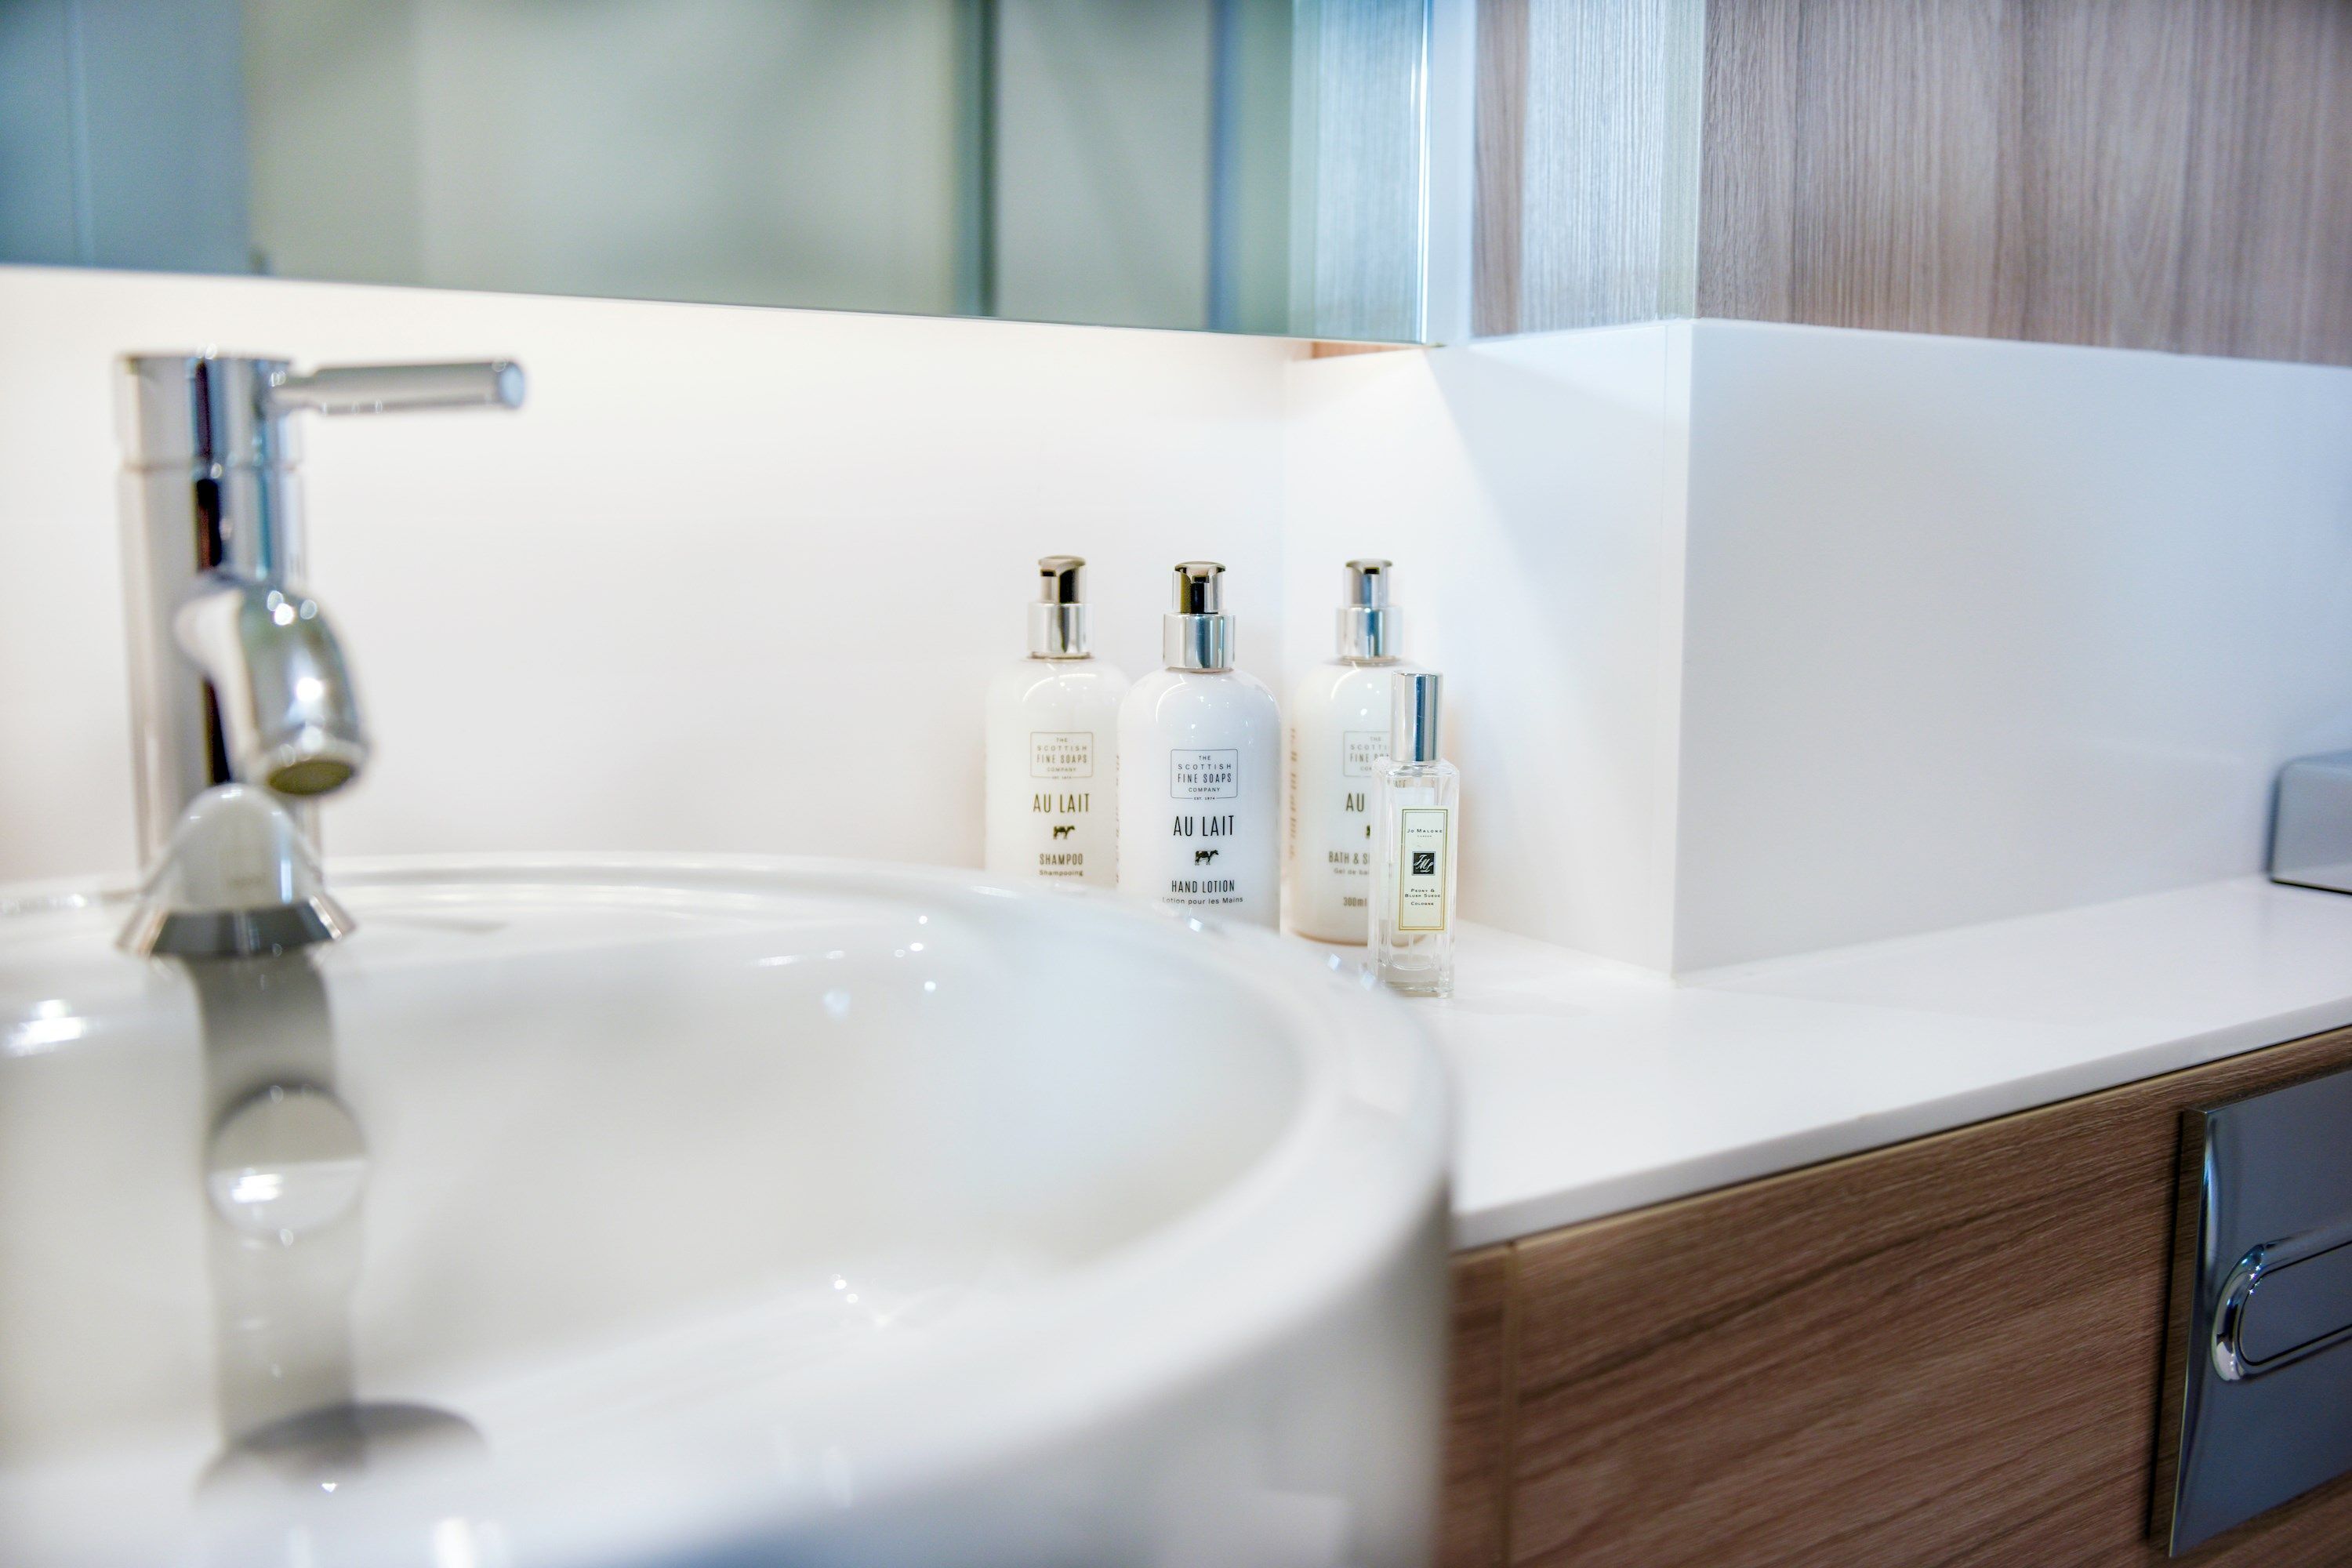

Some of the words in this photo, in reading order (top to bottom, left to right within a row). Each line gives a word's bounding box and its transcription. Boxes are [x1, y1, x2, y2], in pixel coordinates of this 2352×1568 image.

[1037, 754, 1055, 763] FINE
[1060, 754, 1087, 764] SOAPS
[1350, 753, 1369, 762] FINE
[1178, 773, 1198, 783] FINE
[1203, 773, 1231, 783] SOAPS
[1033, 793, 1051, 813] AU
[1060, 793, 1089, 813] LAIT
[1346, 793, 1365, 812] AU
[1173, 816, 1192, 836] AU
[1202, 815, 1234, 836] LAIT
[1040, 853, 1083, 865] SHAMPOO
[1329, 851, 1349, 864] BATH
[1354, 853, 1359, 864] &
[1172, 880, 1197, 893] HAND
[1202, 880, 1235, 893] LOTION
